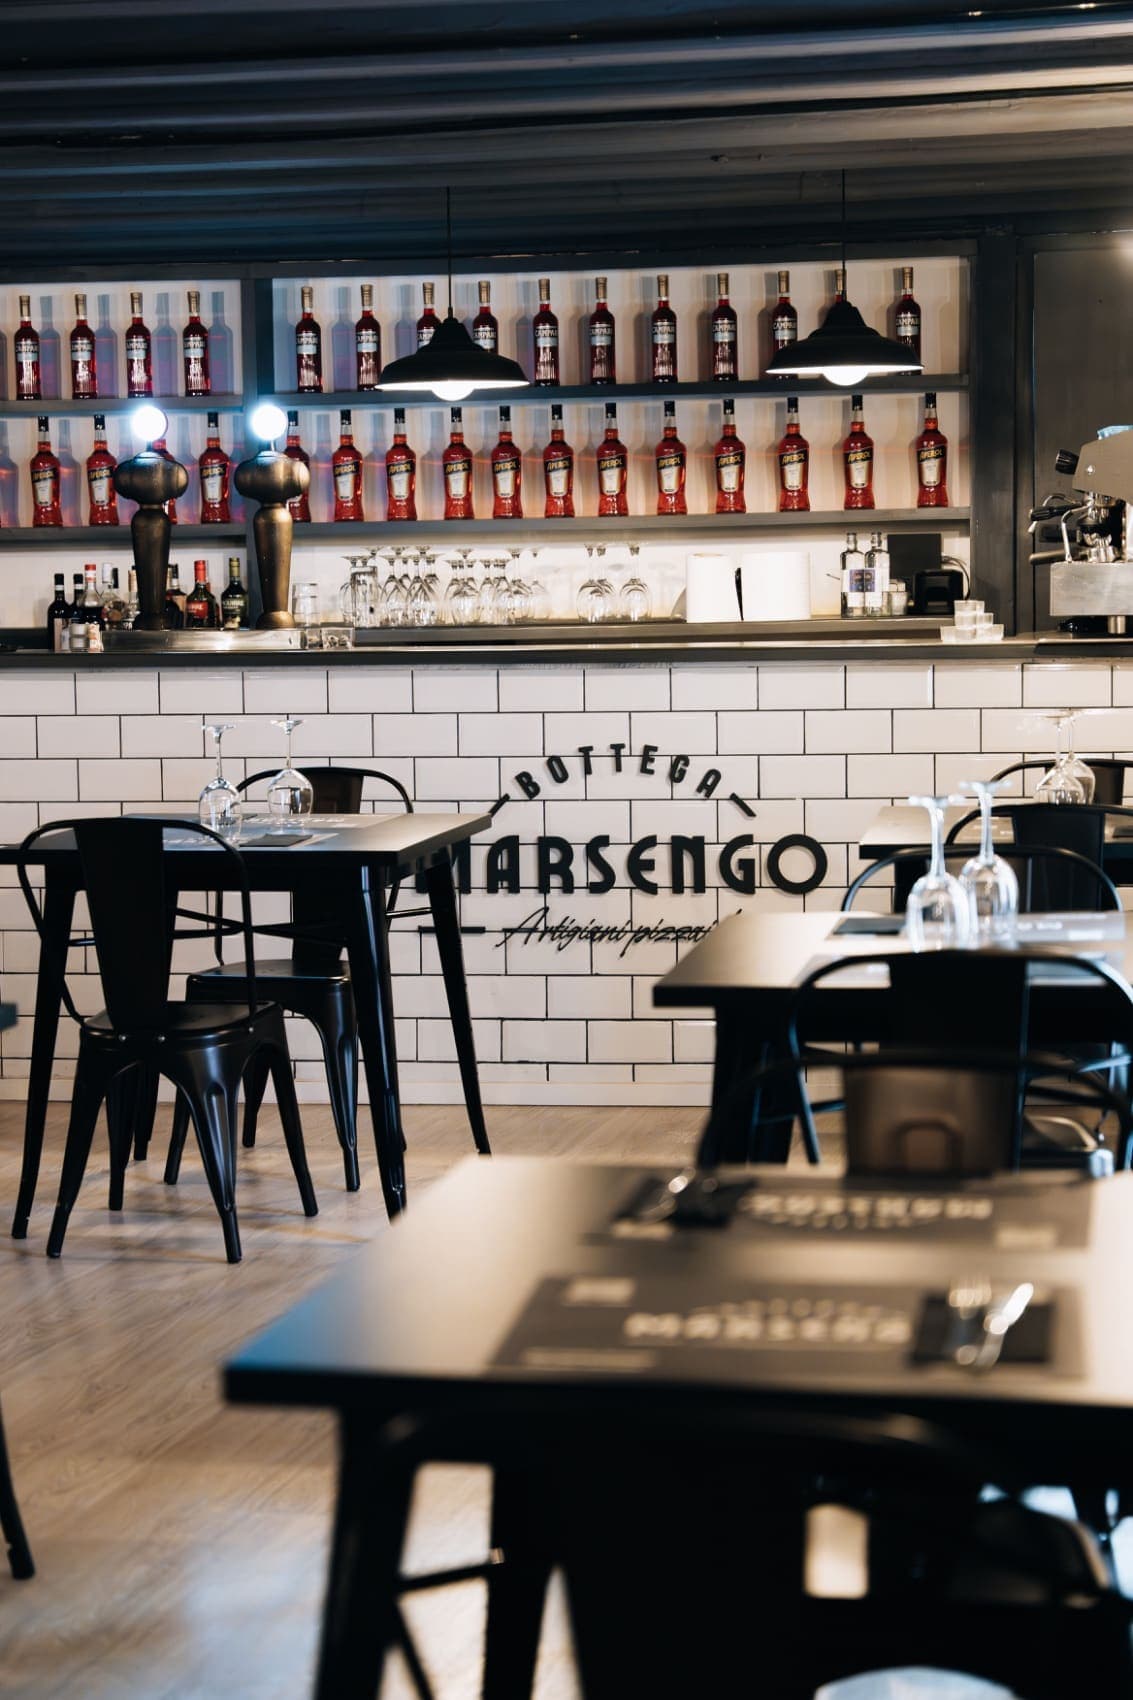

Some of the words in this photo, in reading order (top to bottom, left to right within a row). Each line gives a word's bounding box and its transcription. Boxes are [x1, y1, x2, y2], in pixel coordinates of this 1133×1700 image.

[514, 743, 722, 800] BOTTEGA
[495, 906, 632, 952] Artigiani
[619, 908, 742, 958] pizzai
